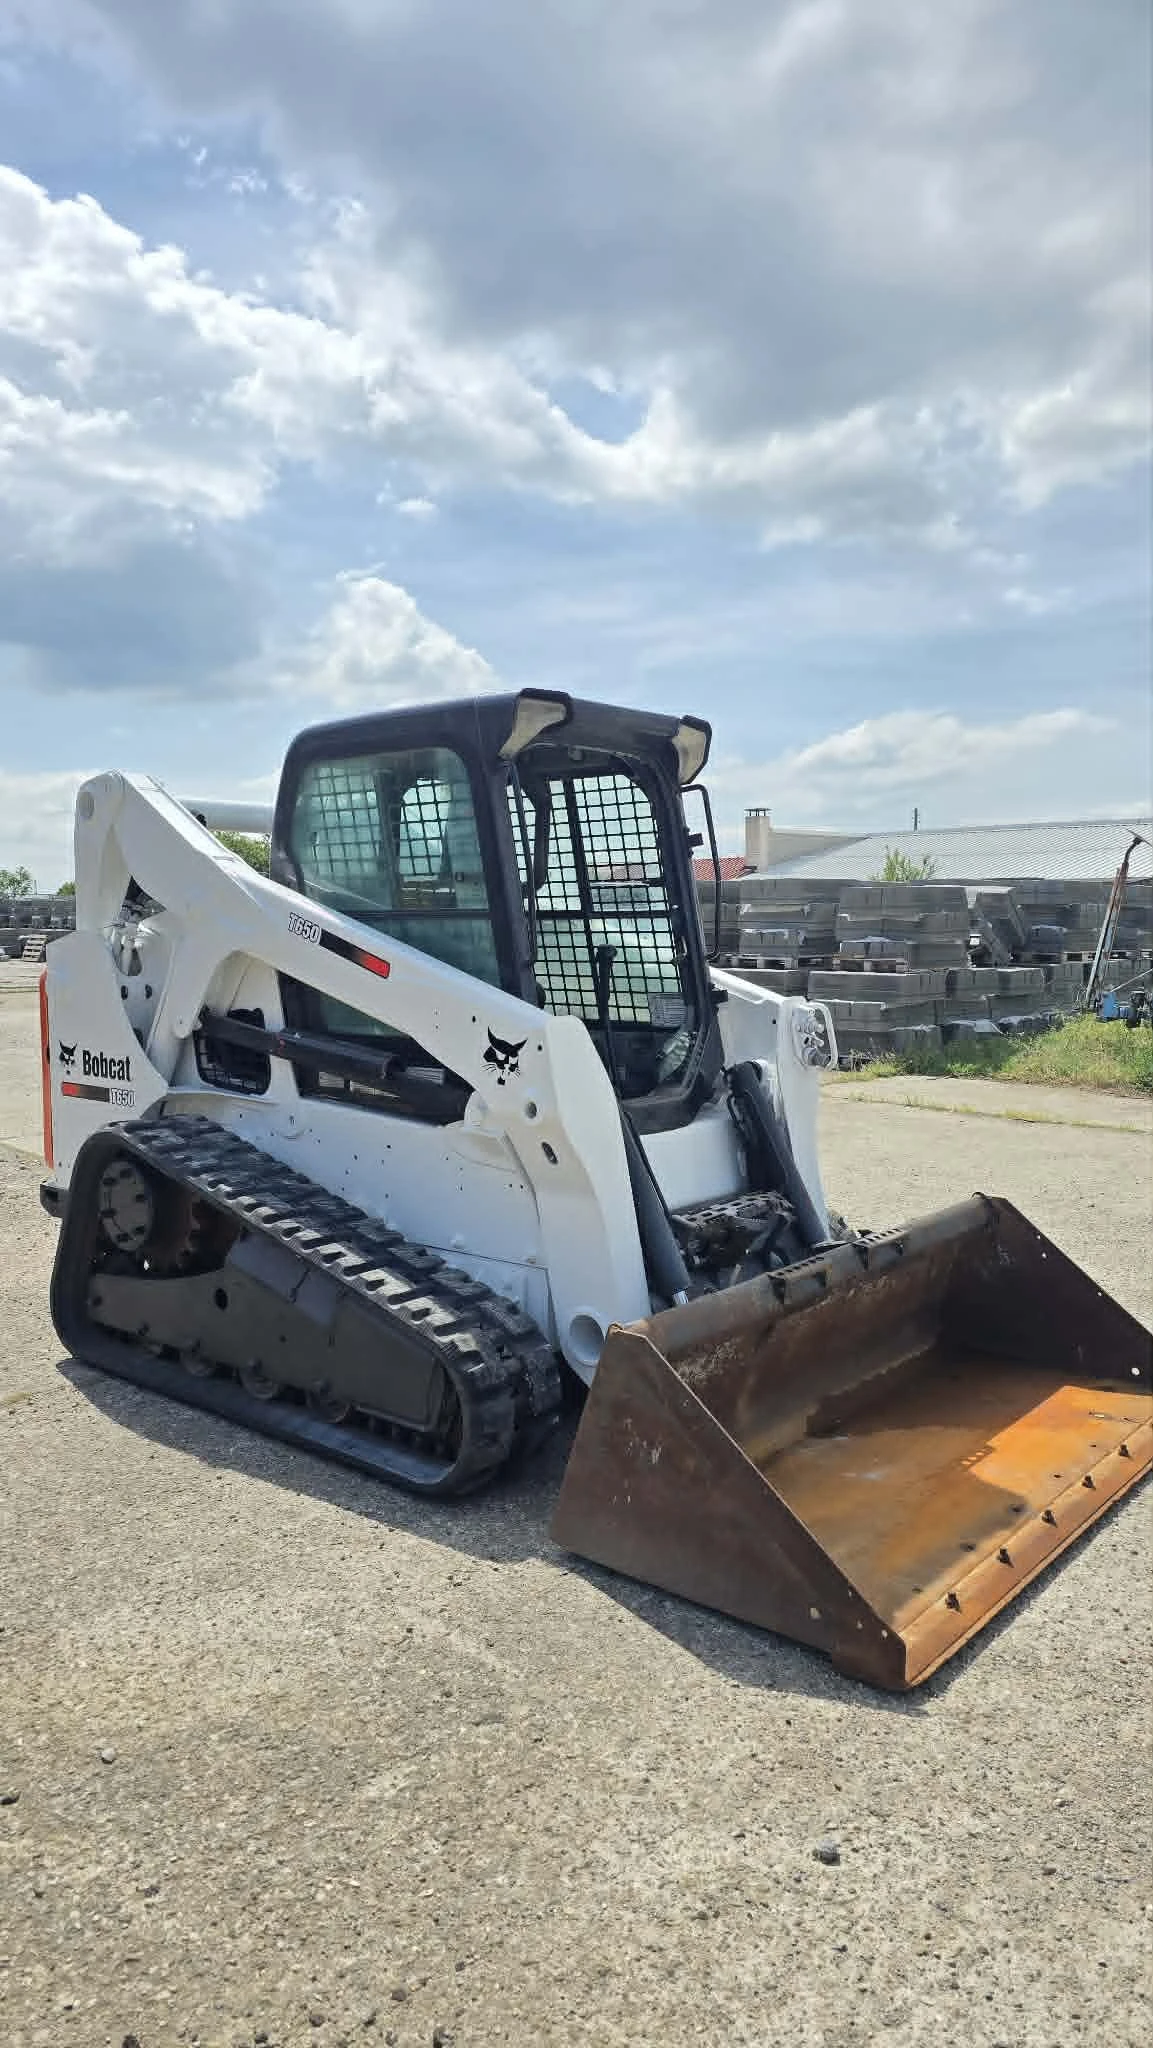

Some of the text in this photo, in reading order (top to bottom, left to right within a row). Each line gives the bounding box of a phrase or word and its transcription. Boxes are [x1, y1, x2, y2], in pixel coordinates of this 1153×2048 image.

[288, 912, 320, 943] T650
[82, 1050, 132, 1082] Bobcat
[110, 1087, 135, 1107] T650
